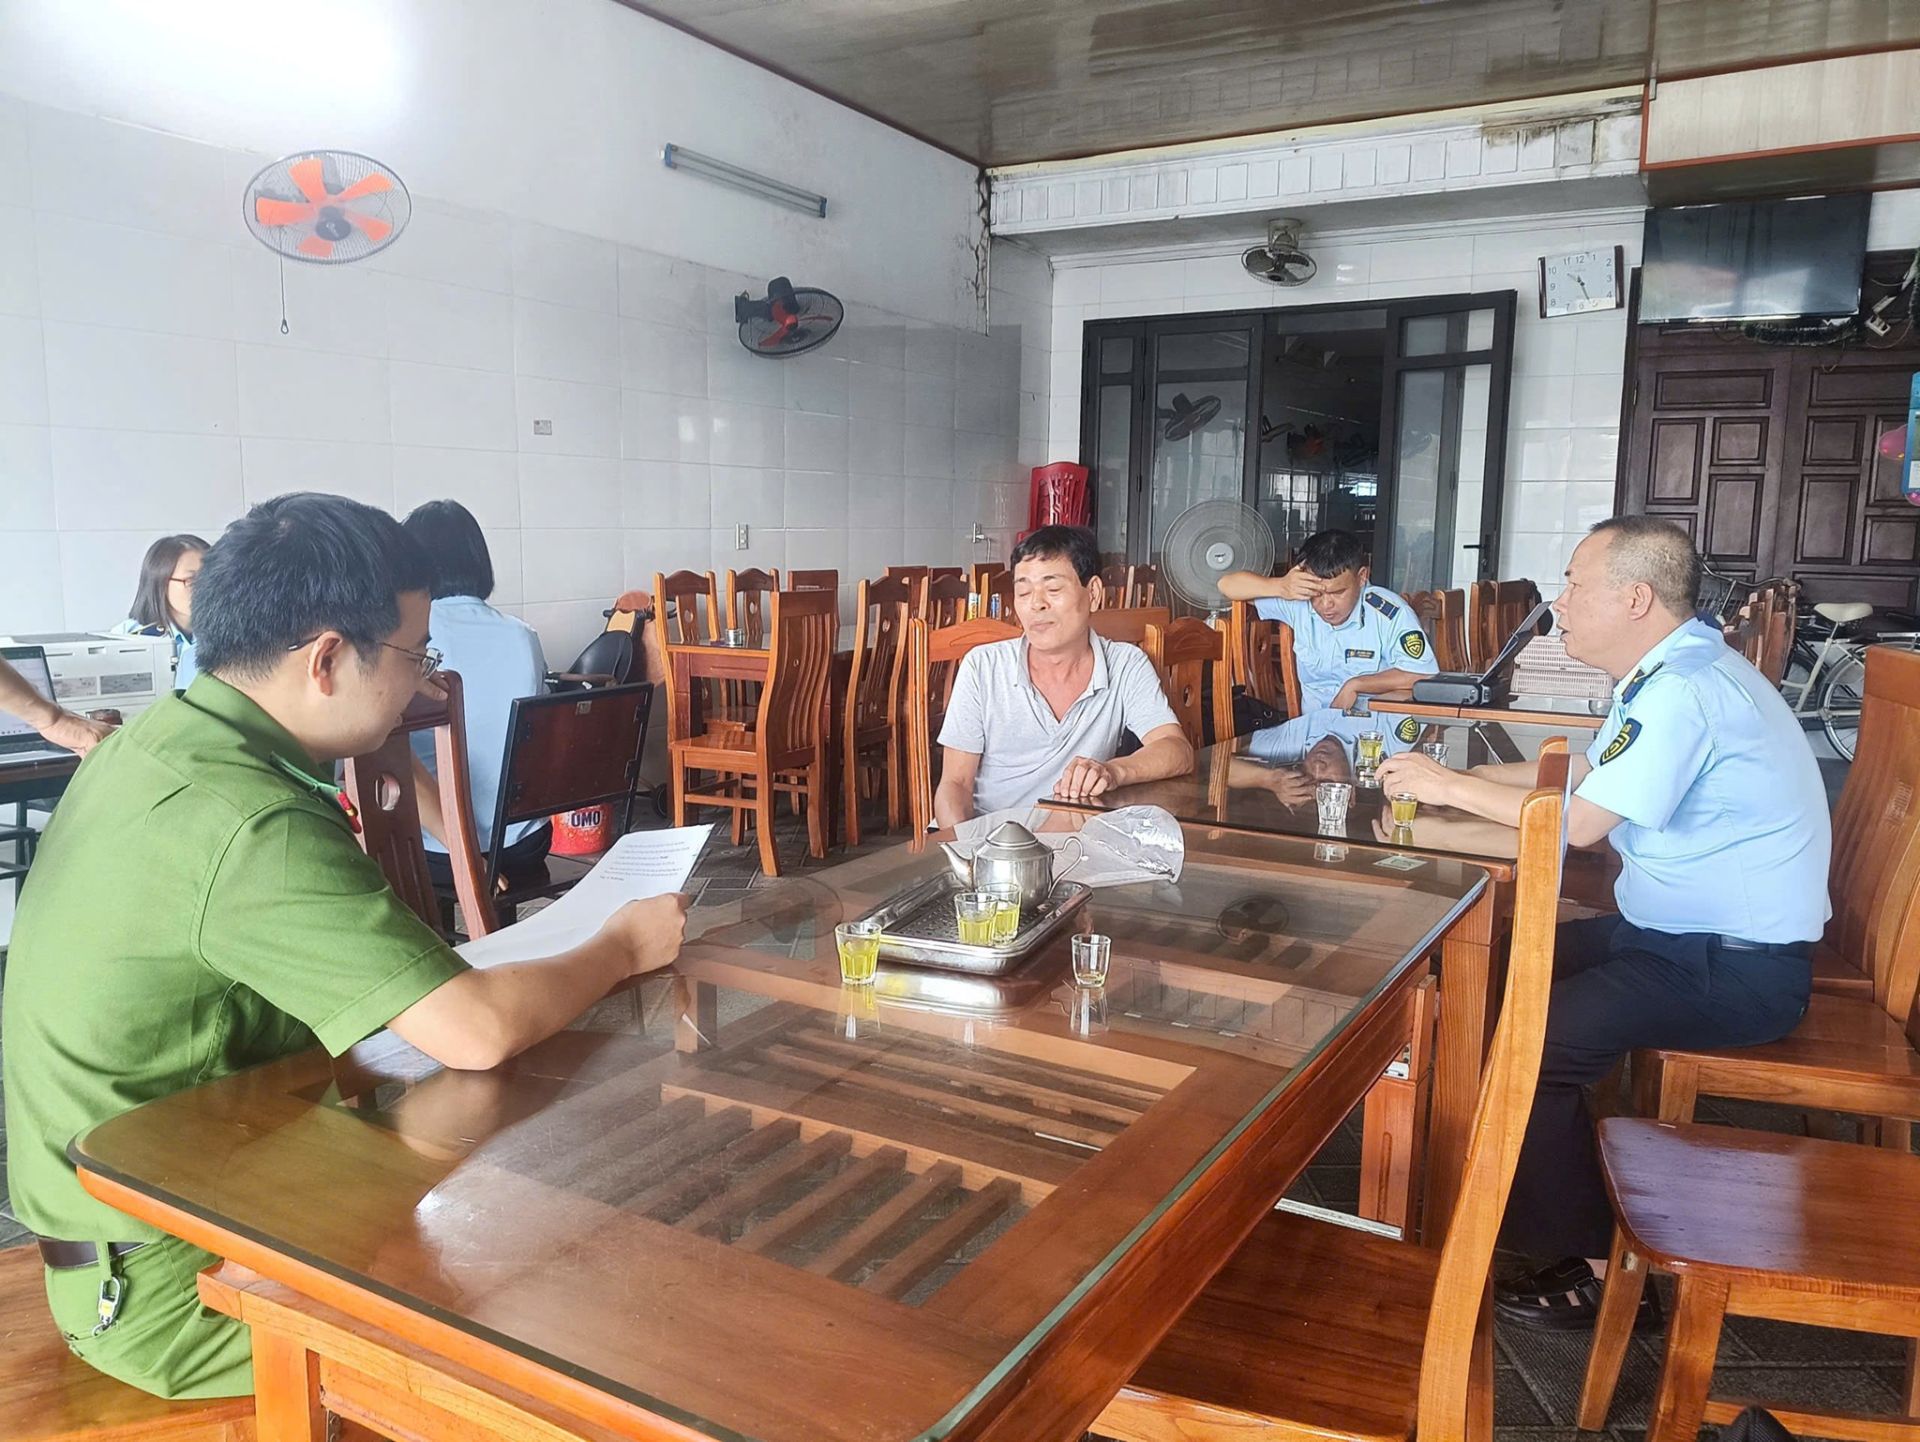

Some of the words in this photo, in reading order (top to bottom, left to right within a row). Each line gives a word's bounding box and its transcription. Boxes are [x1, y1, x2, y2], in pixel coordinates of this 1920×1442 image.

[1563, 256, 1571, 265] 11
[1575, 255, 1585, 264] 12
[1606, 258, 1612, 267] 2
[1548, 266, 1557, 274] 10
[1606, 274, 1612, 283] 3
[1550, 282, 1556, 291] 9
[1606, 290, 1613, 298] 4
[1550, 298, 1557, 307] 8
[1564, 303, 1570, 311] 7
[571, 810, 601, 827] OMO
